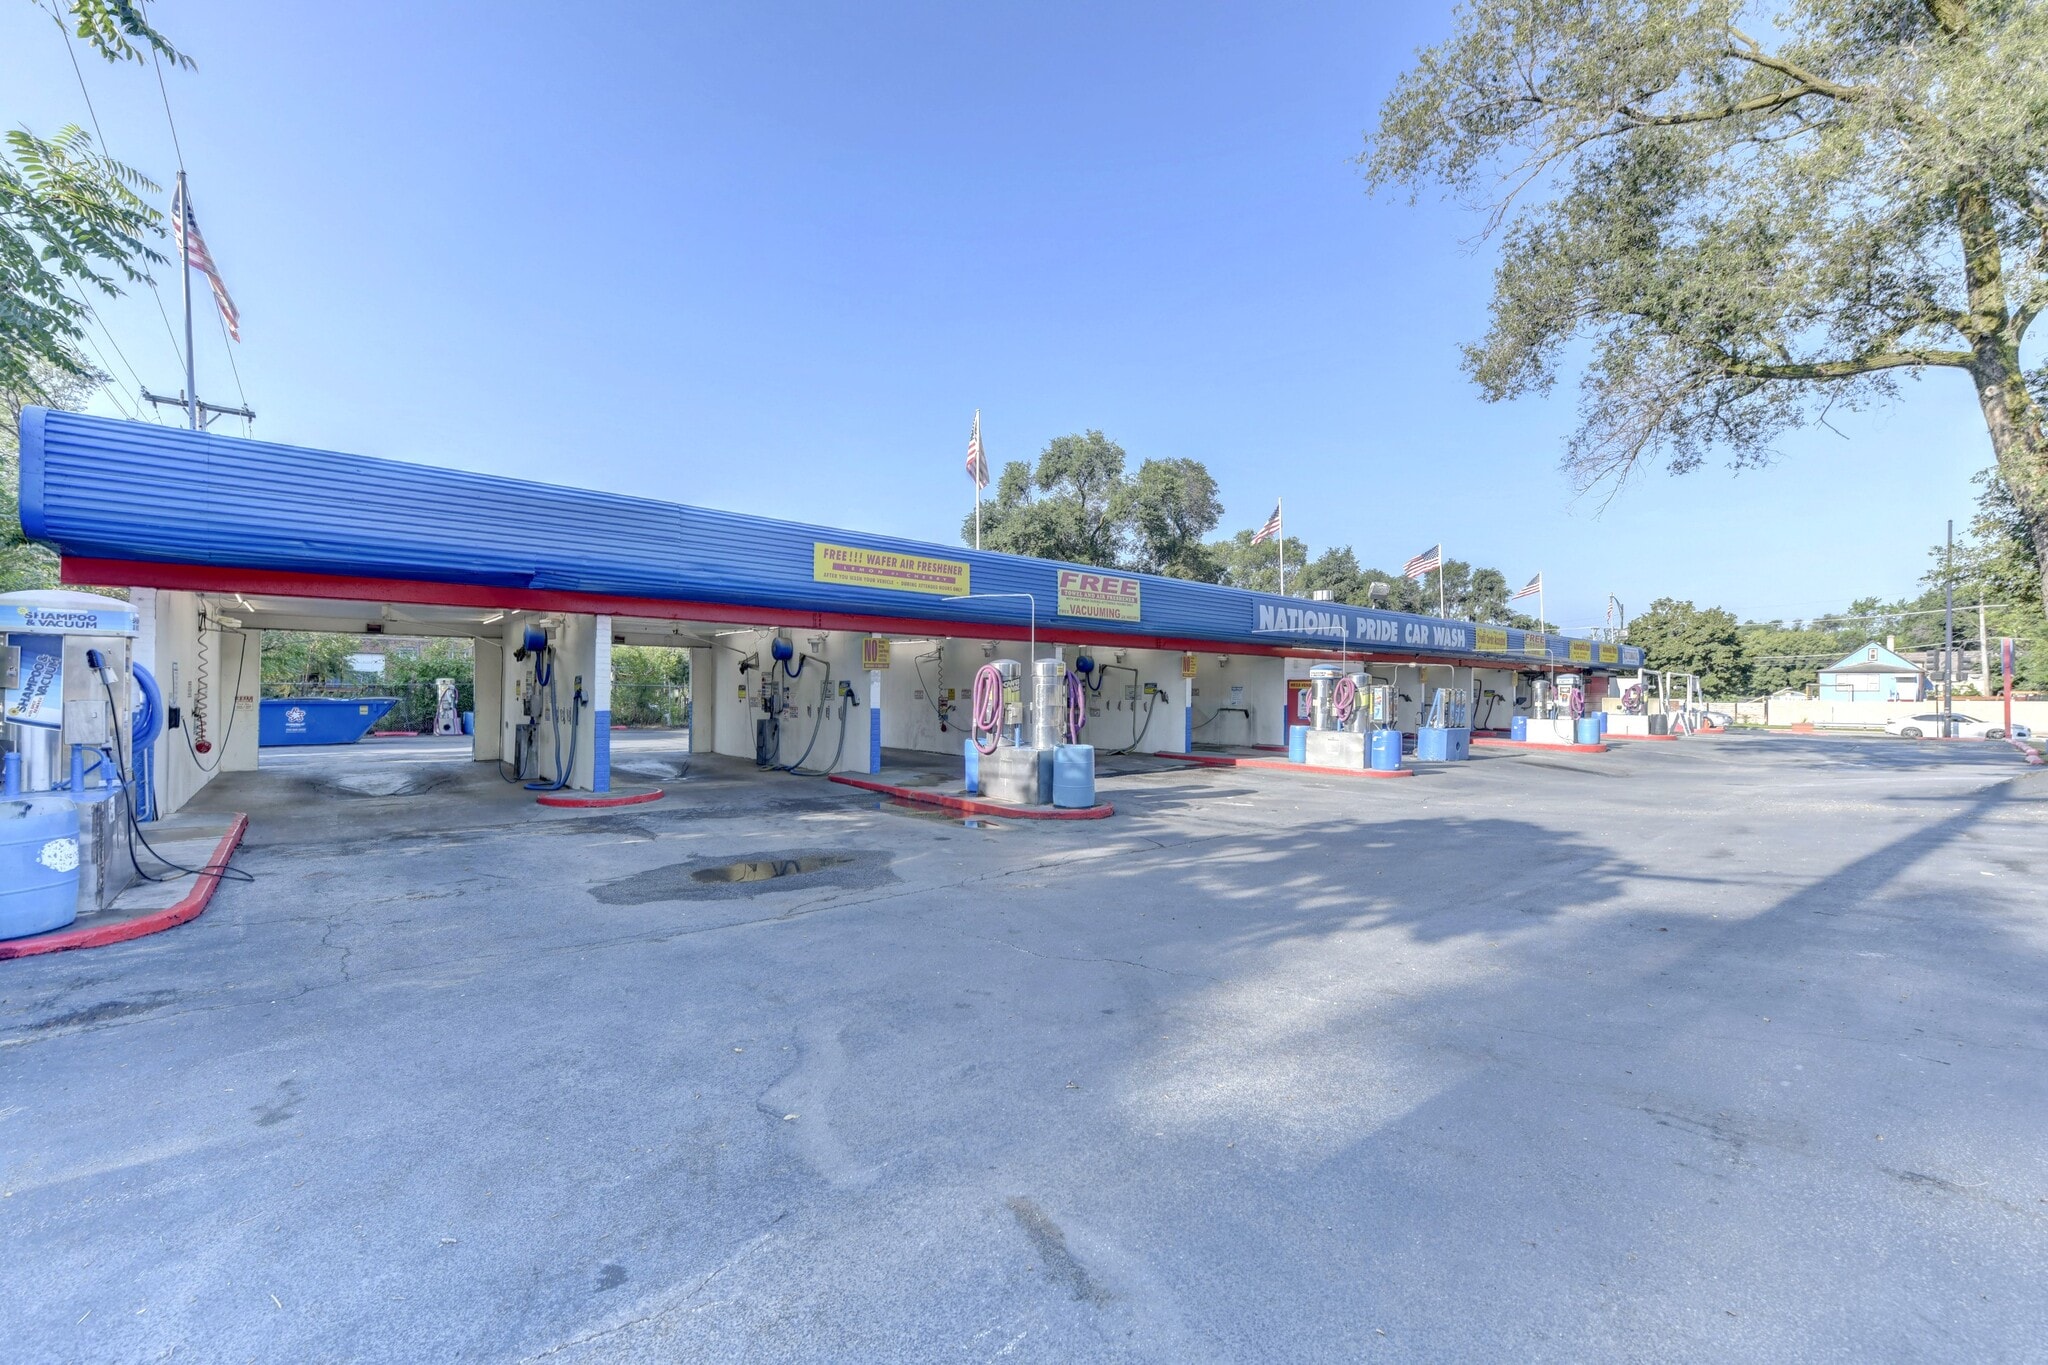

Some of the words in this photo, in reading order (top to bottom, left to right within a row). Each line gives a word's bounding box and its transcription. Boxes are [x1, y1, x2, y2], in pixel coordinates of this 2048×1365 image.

[844, 566, 884, 574] LEMON
[906, 572, 948, 582] CHERRY
[866, 554, 898, 568] WAFER
[900, 558, 914, 570] AIR
[917, 561, 962, 576] FRESHENER
[1060, 572, 1138, 595] FREE
[24, 612, 97, 621] SHAMPOO
[1070, 604, 1120, 618] VACUUMING
[38, 620, 97, 628] VACUUM
[1259, 605, 1349, 638] NATIONAL
[1356, 617, 1398, 642] PRIDE
[1405, 623, 1429, 644] CAR
[1433, 626, 1465, 648] WASH
[1526, 634, 1545, 644] FREE
[865, 640, 878, 662] NO
[17, 663, 44, 713] SHAMPOO
[37, 654, 50, 664] &
[35, 656, 61, 696] VACUUM
